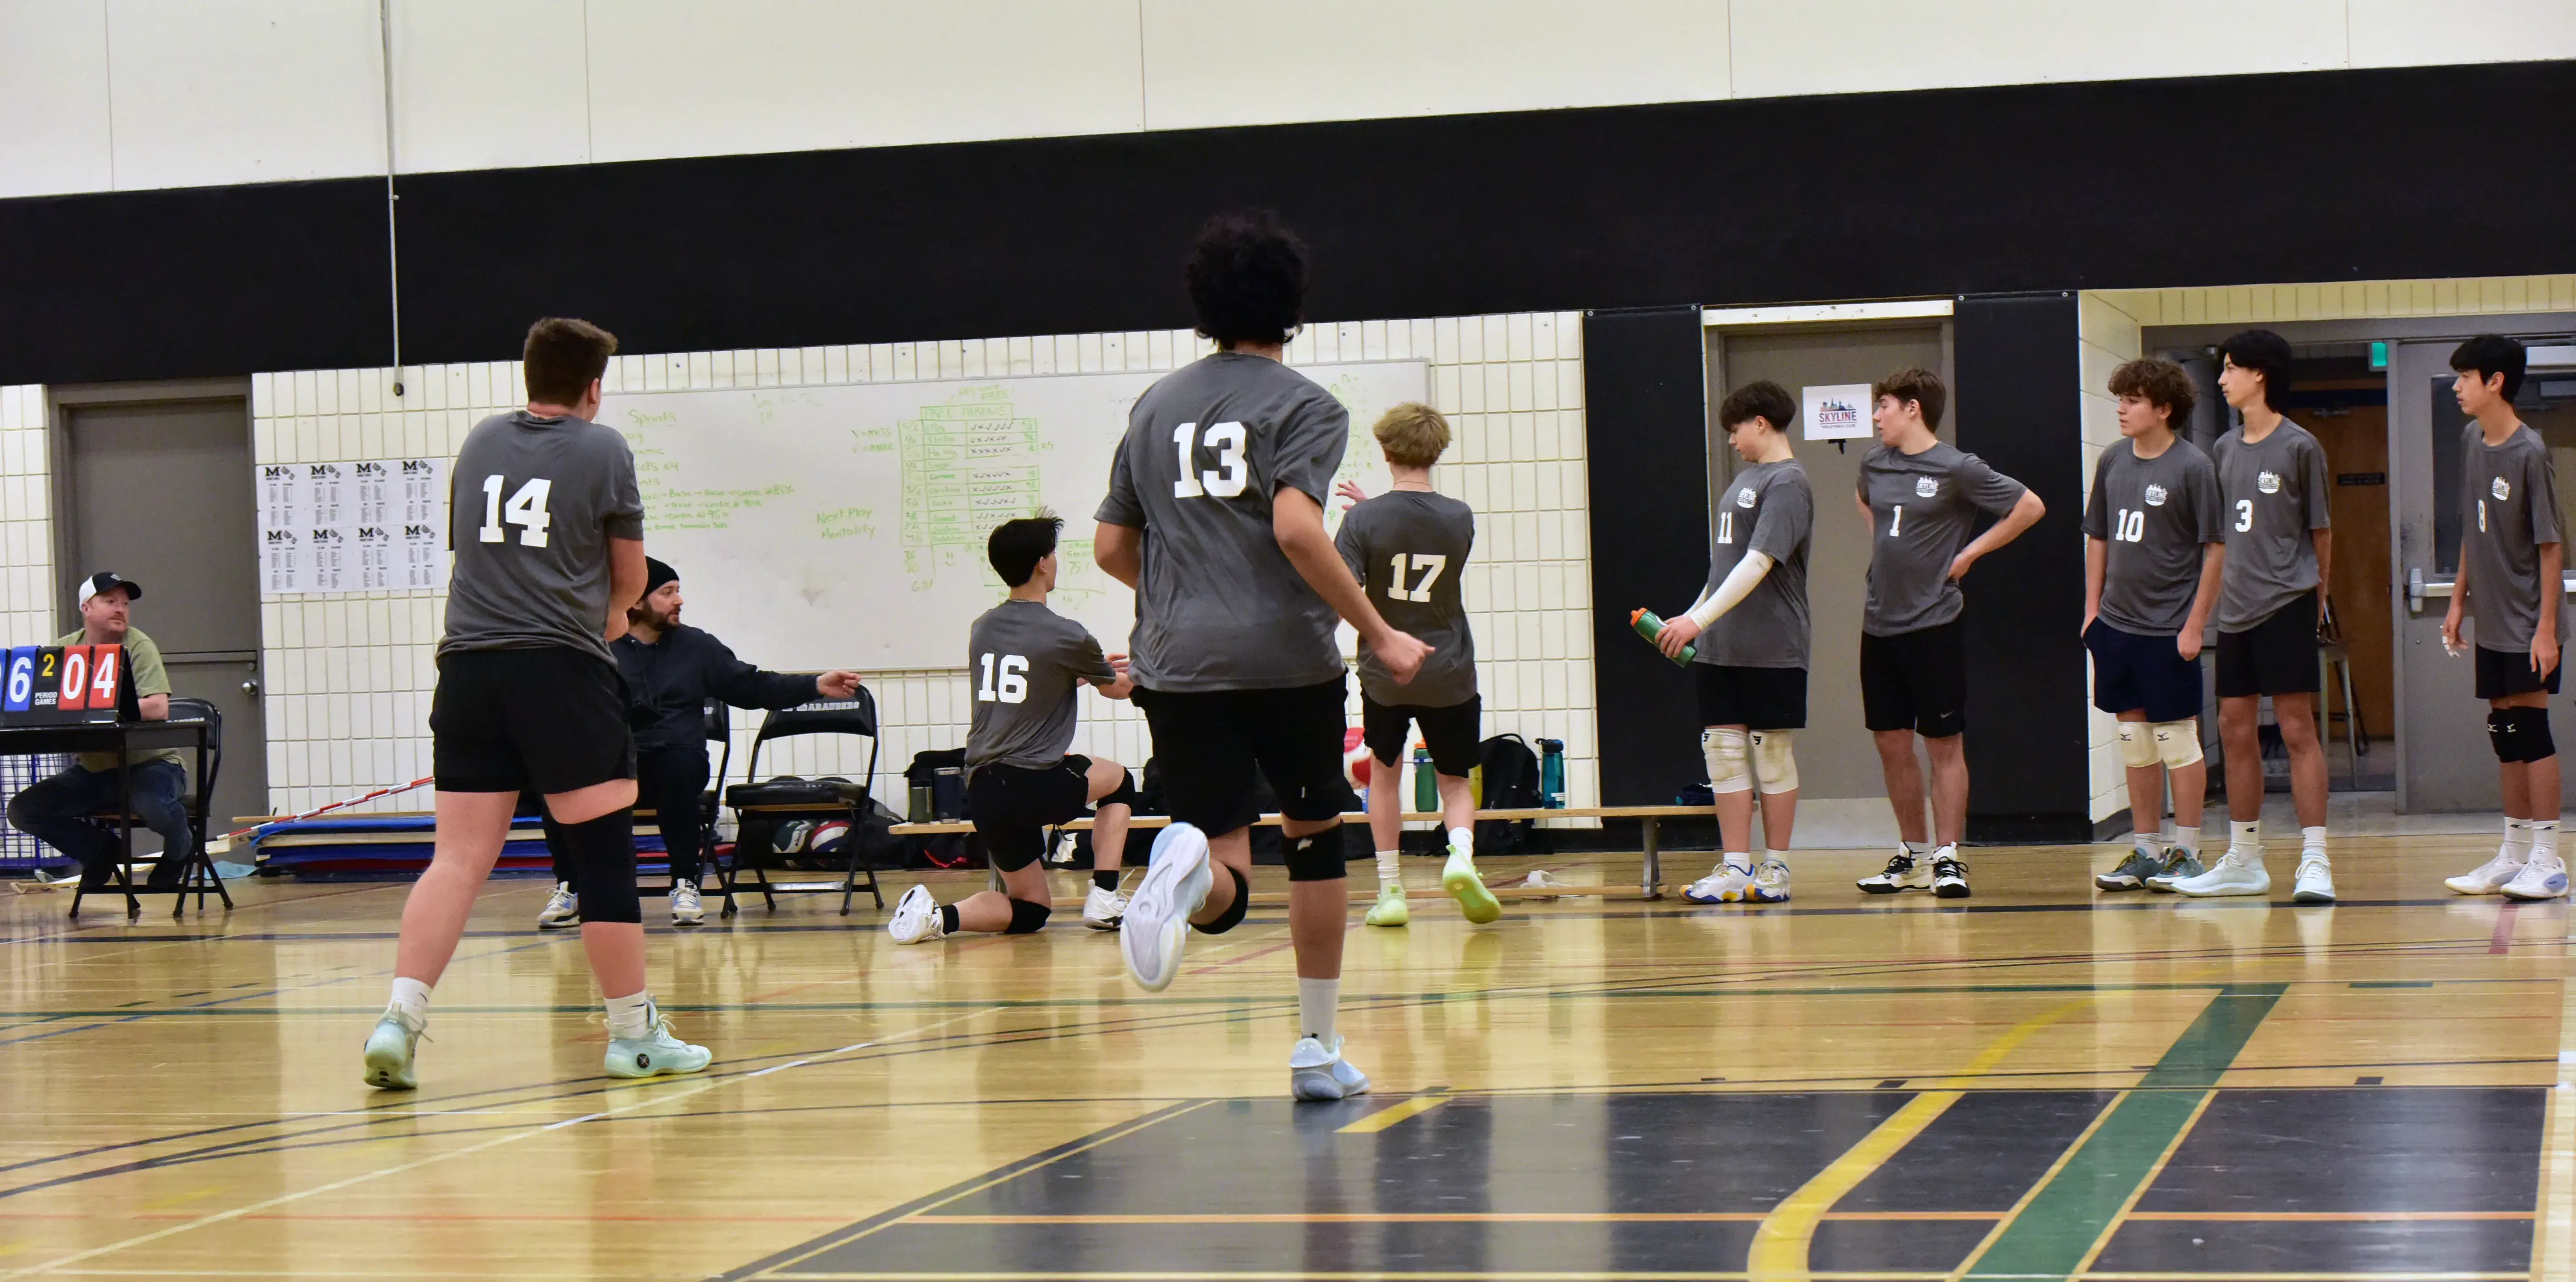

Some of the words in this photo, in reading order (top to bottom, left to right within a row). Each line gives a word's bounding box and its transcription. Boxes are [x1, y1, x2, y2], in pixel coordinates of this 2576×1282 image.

[1820, 411, 1857, 422] SKYLINE
[403, 461, 418, 470] M
[1174, 421, 1247, 498] 13
[266, 467, 280, 476] M
[311, 465, 326, 475] M
[357, 463, 371, 473] M
[480, 475, 552, 547] 14
[817, 508, 846, 524] Next
[848, 507, 872, 519] Play
[2235, 499, 2253, 532] 3
[1717, 512, 1732, 544] 11
[1889, 505, 1902, 537] 1
[2115, 509, 2144, 542] 10
[267, 531, 282, 540] M
[313, 529, 328, 539] M
[359, 527, 374, 538] M
[405, 525, 420, 535] M
[822, 523, 875, 539] Mentality
[1388, 553, 1446, 602] 17
[42, 654, 55, 676] 2
[978, 653, 1029, 703] 16
